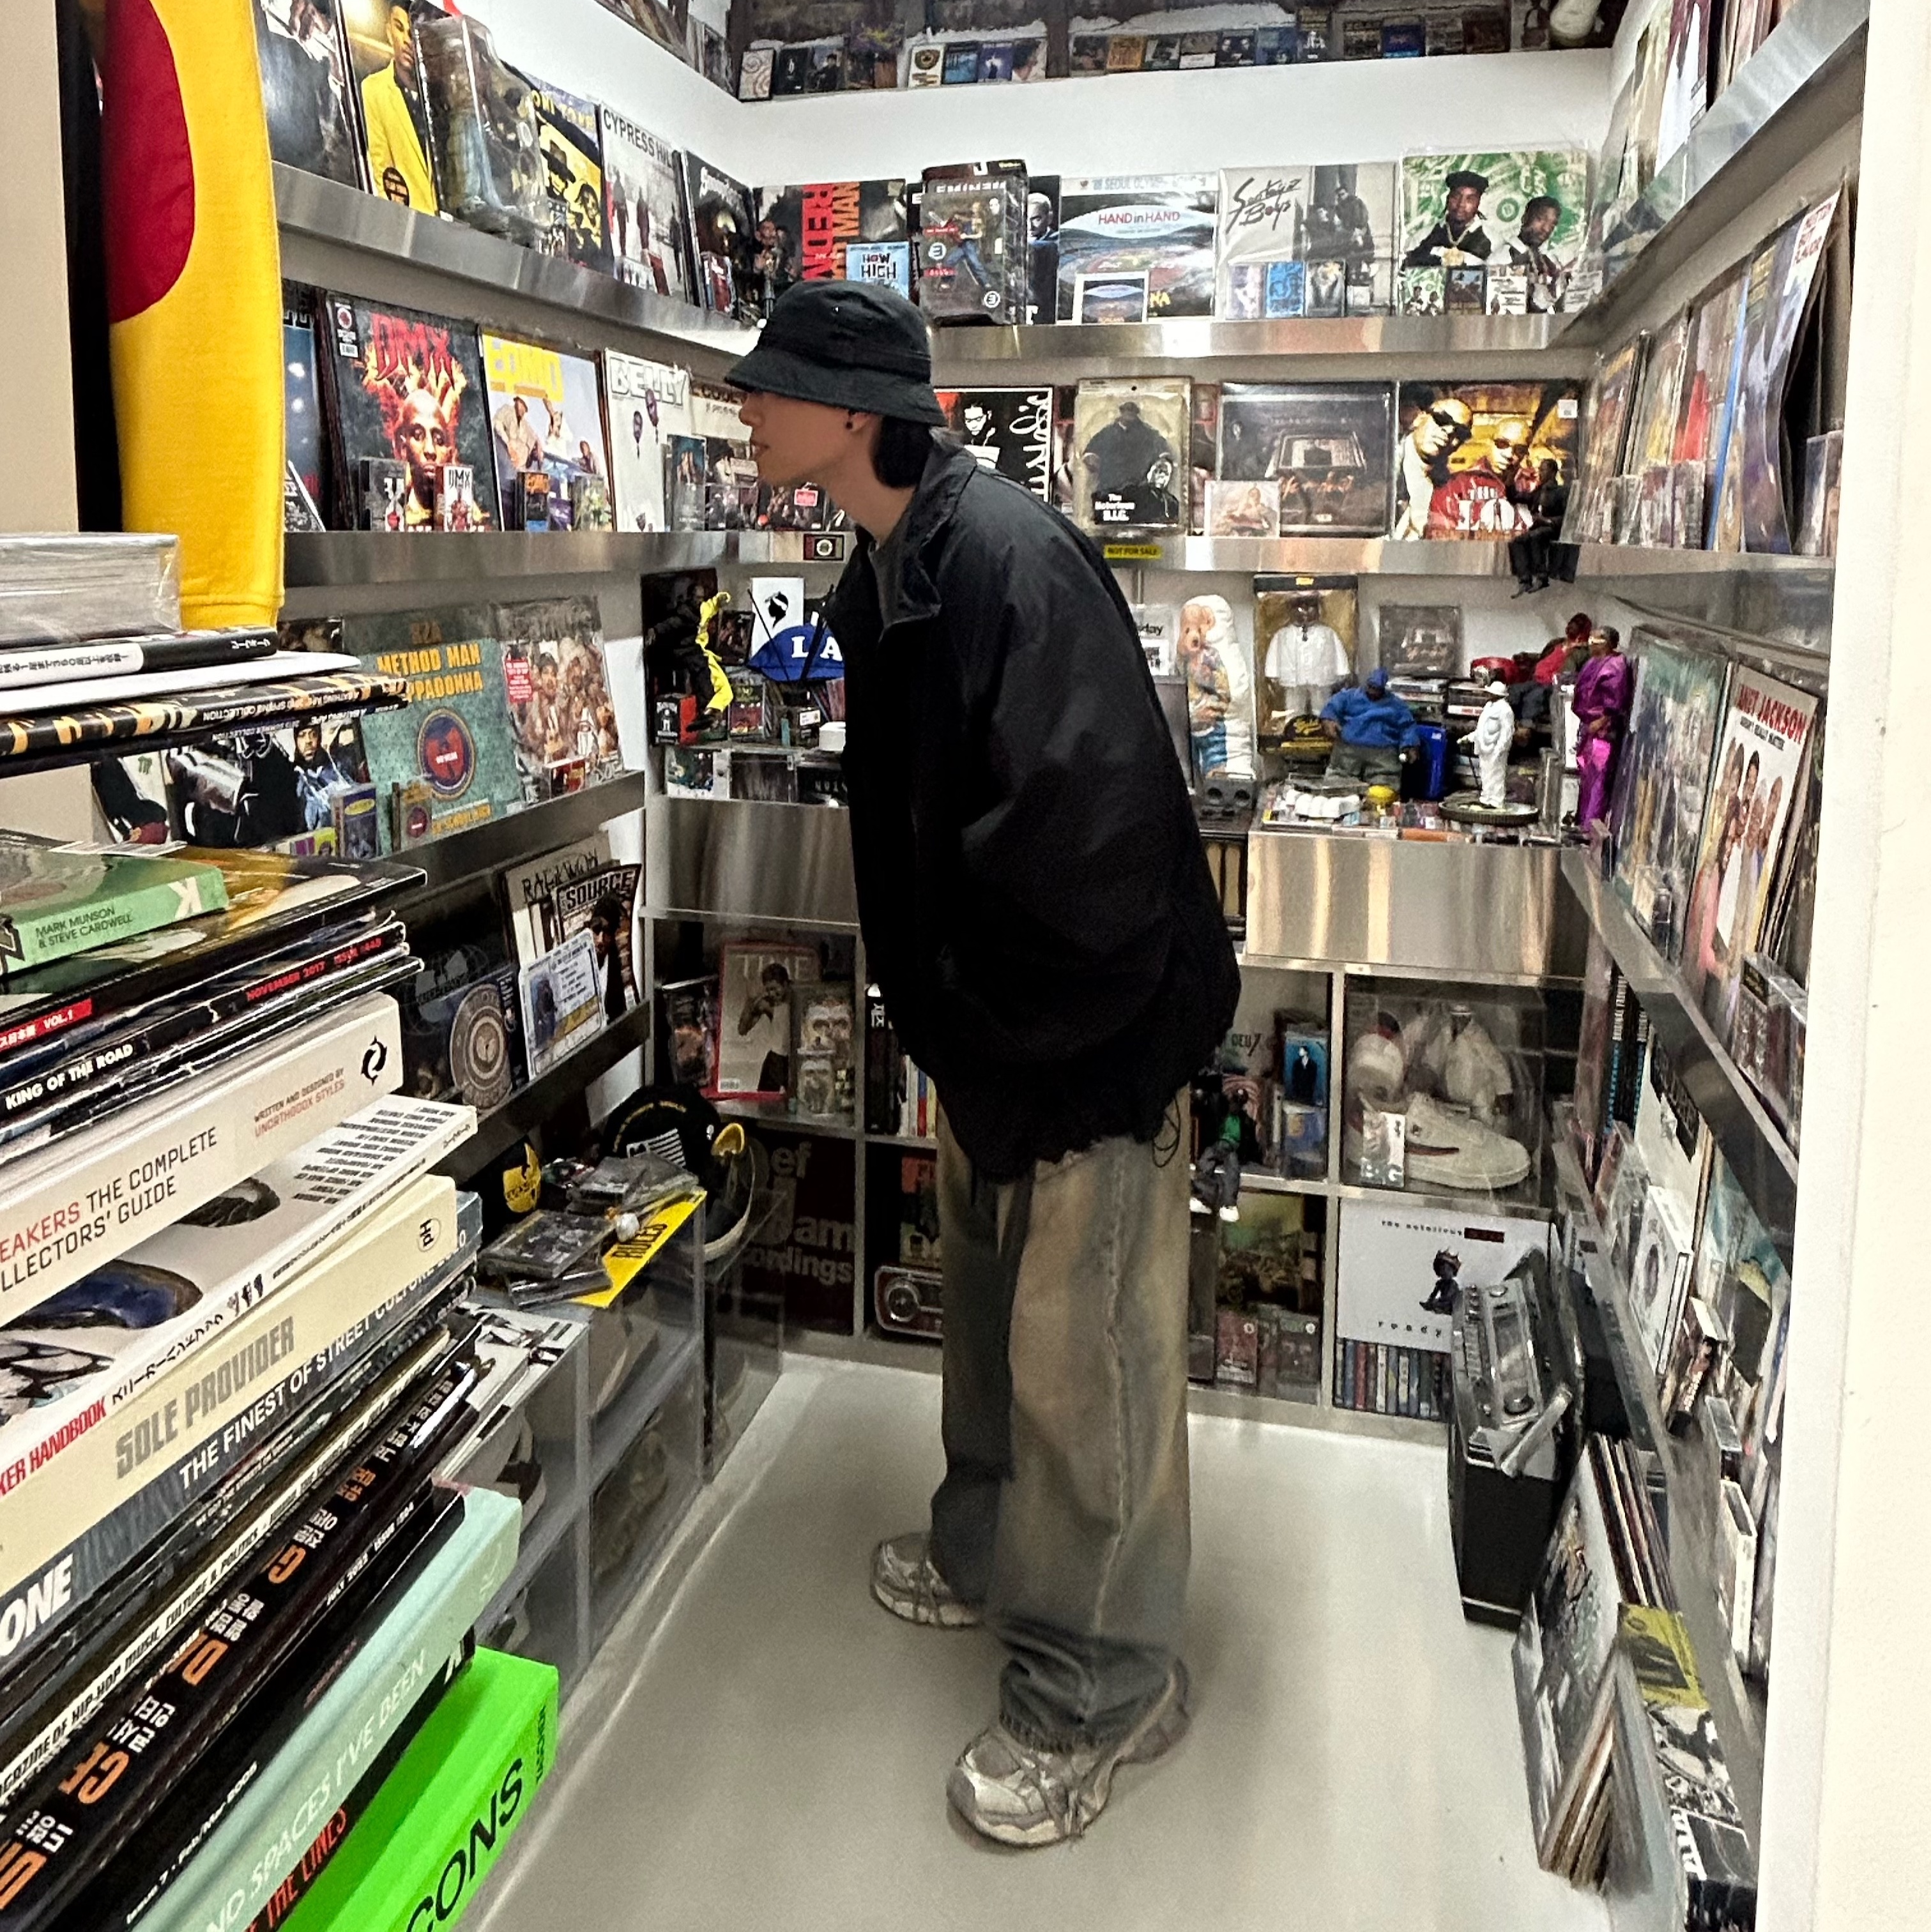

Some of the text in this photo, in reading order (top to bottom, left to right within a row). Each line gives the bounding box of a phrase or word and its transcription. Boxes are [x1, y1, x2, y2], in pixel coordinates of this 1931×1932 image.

[604, 109, 655, 157] CYPRESS
[936, 181, 1007, 193] EMINEM
[1098, 211, 1180, 225] HAND in HAND
[860, 261, 896, 279] HIGH
[862, 252, 890, 264] HOW
[1149, 291, 1171, 308] NA
[369, 312, 451, 391] DMX
[610, 356, 687, 407] BELLY
[448, 469, 471, 490] DMX
[376, 643, 481, 677] METHOD MAN
[405, 671, 484, 703] PPADONNA
[203, 704, 256, 722] COLLECTION
[35, 906, 116, 938] MARK MUNSON
[38, 913, 133, 948] & STEVE CARDWELL
[246, 970, 301, 1001] NOVEMBER
[303, 960, 326, 979] 2017
[5, 1044, 134, 1111] KING OF THE ROAD
[254, 1067, 345, 1122] WRITTEN AND DESIGNED BY
[254, 1079, 345, 1137] UNORTHODOX STYLES
[0, 1201, 81, 1264] EAKERS
[86, 1178, 123, 1213] THE
[128, 1126, 218, 1190] COMPLETE
[0, 1175, 178, 1293] LLECTORS' GUIDE
[1377, 1320, 1442, 1338] ready
[115, 1399, 179, 1480] SOLE
[184, 1316, 294, 1429] PROVIDER
[179, 1443, 218, 1489] THE
[222, 1383, 291, 1454] FINEST
[289, 1352, 313, 1396] OF
[316, 1317, 372, 1374] STREET
[0, 1397, 107, 1496] KER HANDBOOK
[326, 1580, 346, 1607] JULY
[372, 1522, 397, 1555] ISSUE
[0, 1553, 74, 1657] ONE
[70, 1668, 123, 1728] HIP-HOP
[164, 1581, 208, 1629] CULTURE
[209, 1570, 219, 1586] &
[249, 1772, 330, 1900] SPACES
[336, 1715, 376, 1787] I'VE
[379, 1648, 427, 1730] BEEN
[266, 1803, 347, 1928] THE LINES
[126, 1879, 158, 1924] Issue
